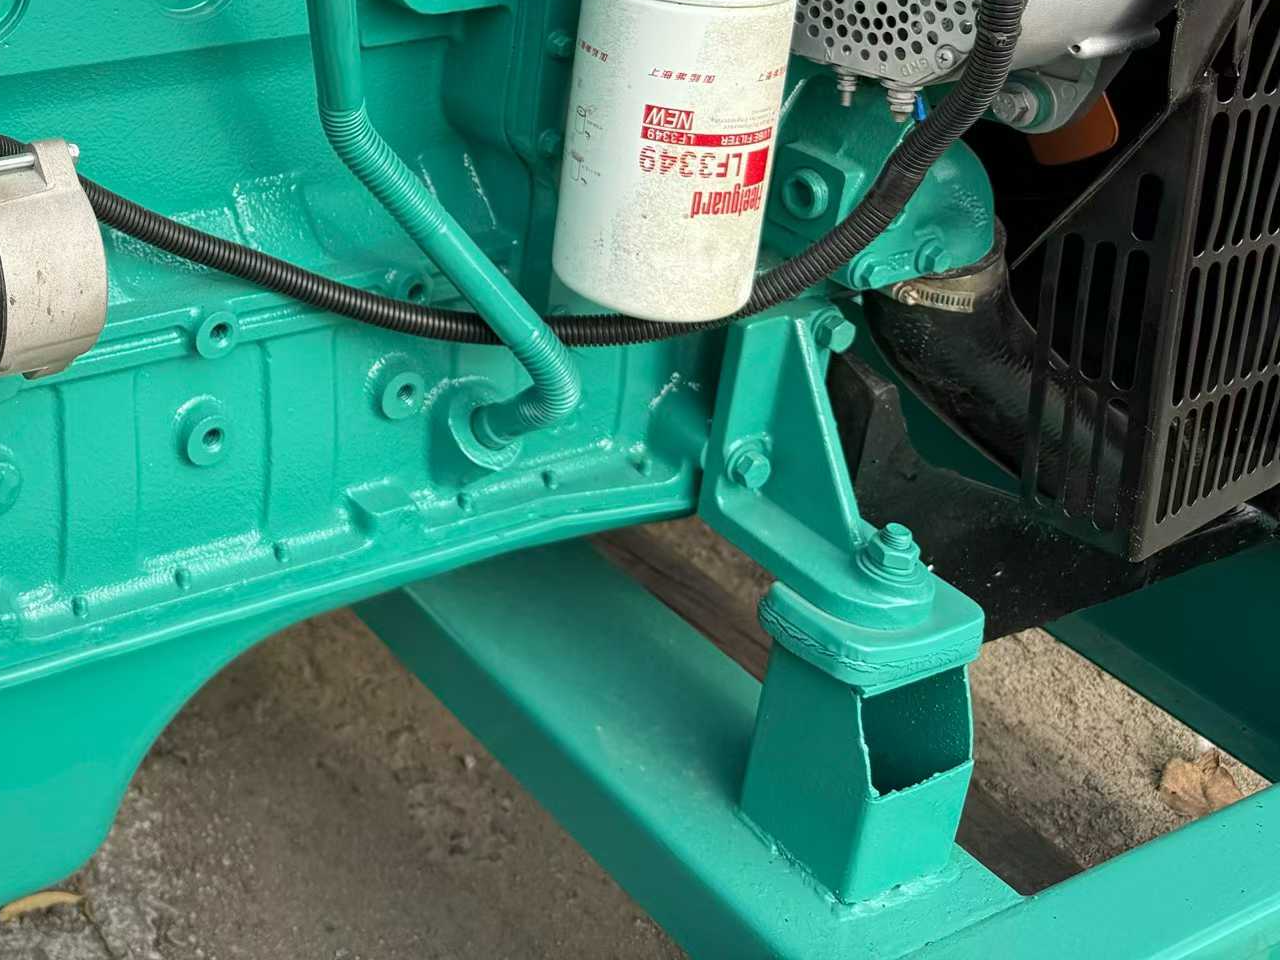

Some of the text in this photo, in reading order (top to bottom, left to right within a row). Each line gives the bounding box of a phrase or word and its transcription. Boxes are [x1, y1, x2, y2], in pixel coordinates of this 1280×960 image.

[645, 106, 694, 130] NEW
[647, 128, 696, 145] LF3349
[721, 131, 753, 146] FILTER
[639, 145, 743, 178] LF3349
